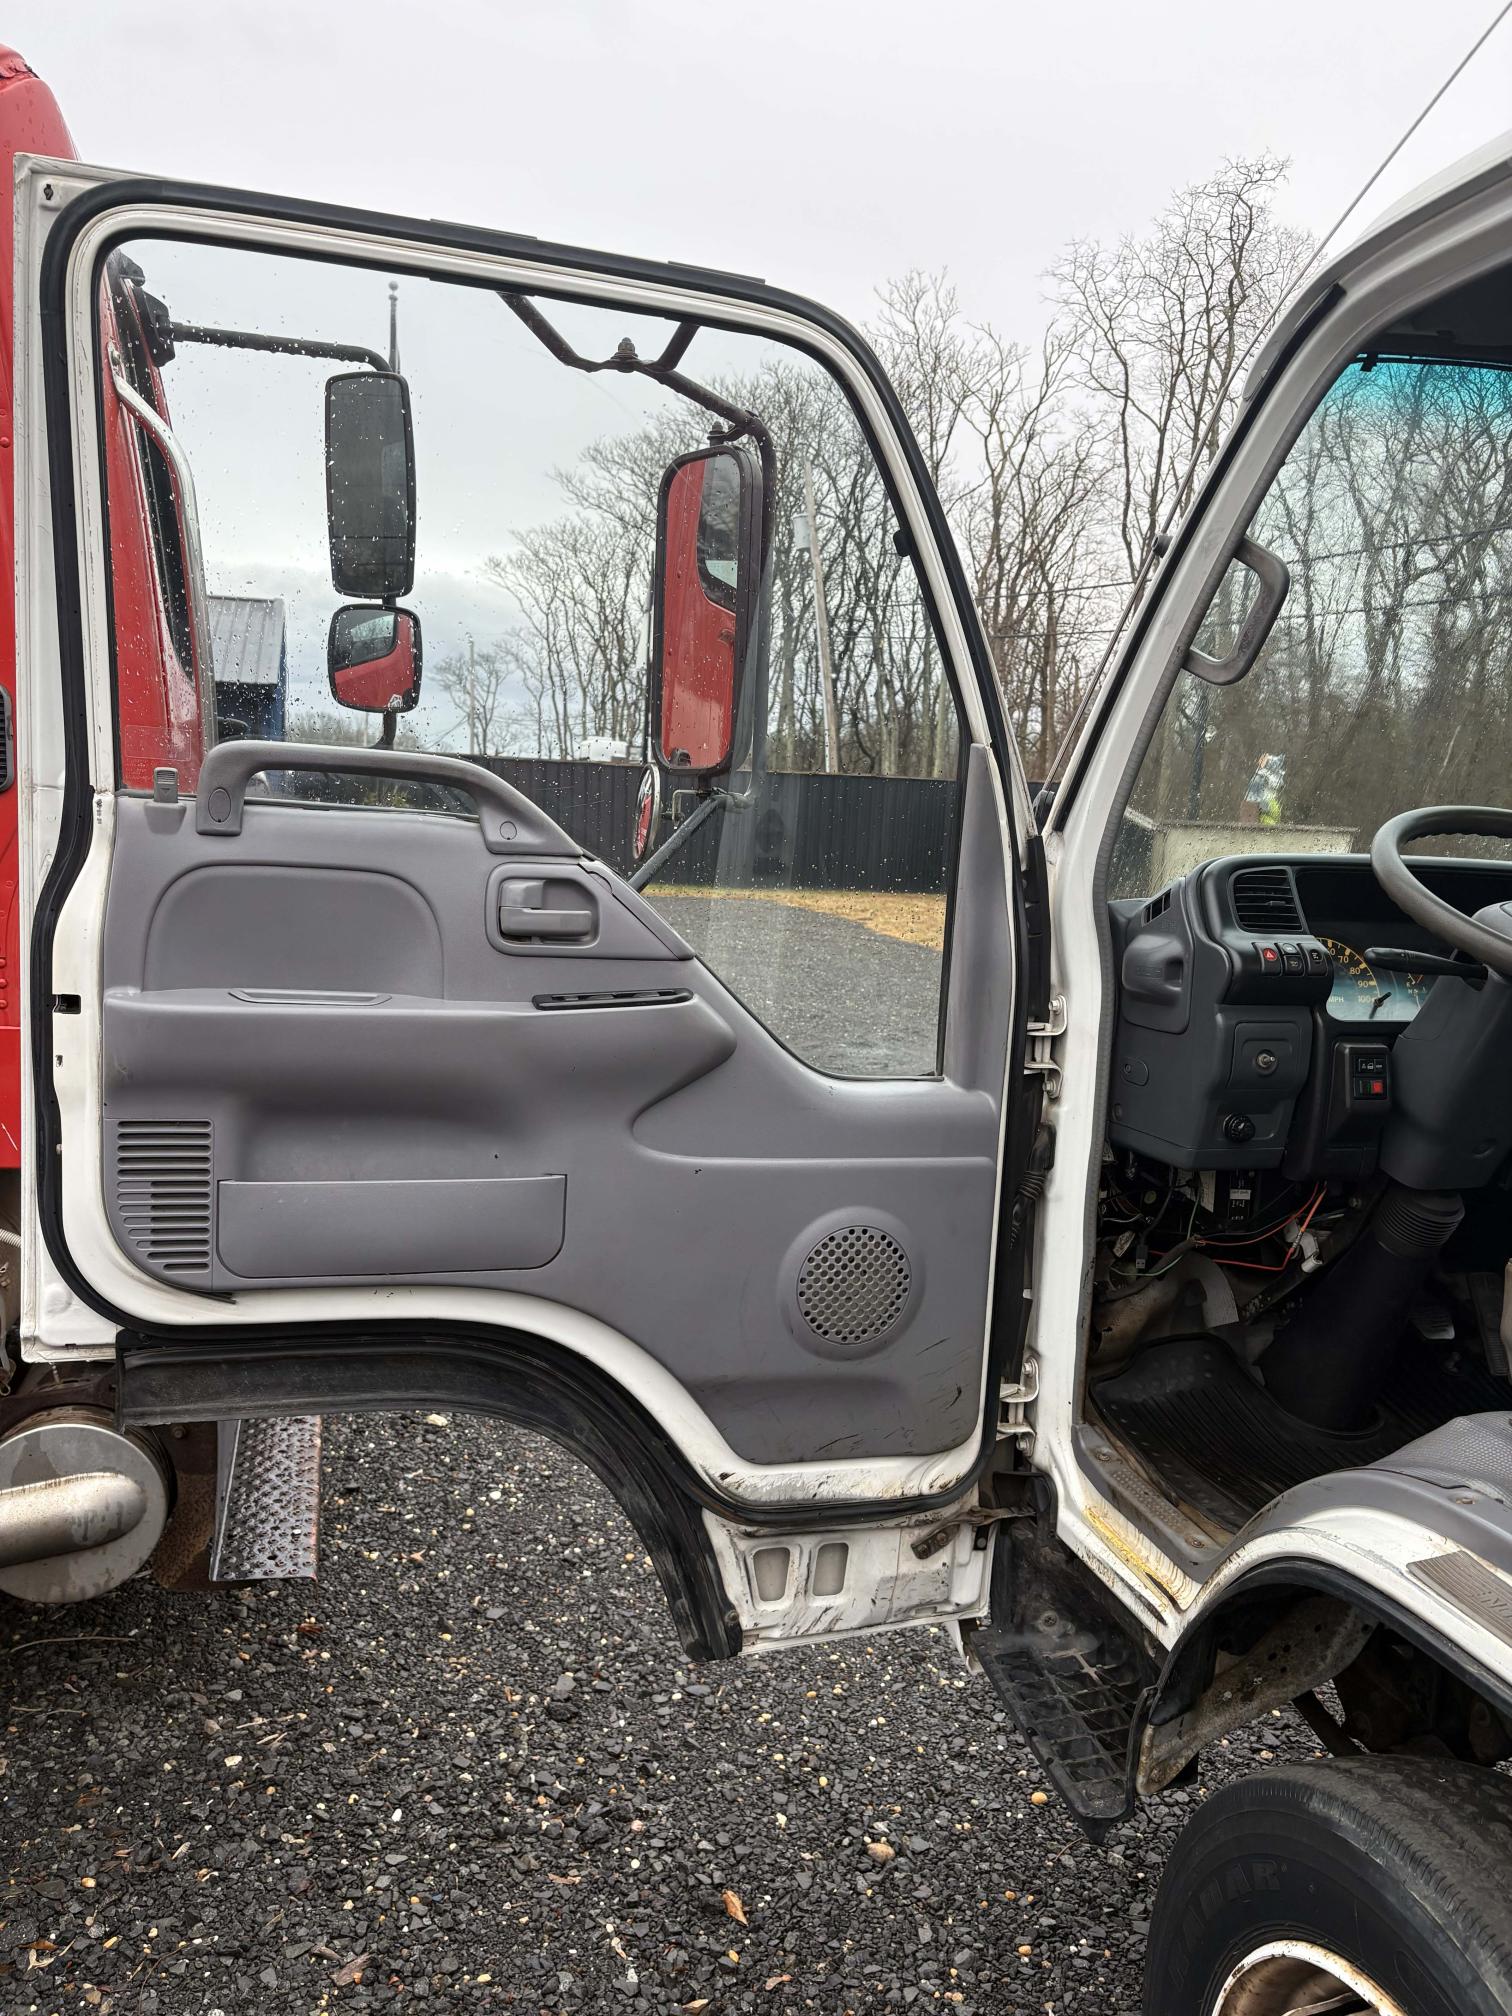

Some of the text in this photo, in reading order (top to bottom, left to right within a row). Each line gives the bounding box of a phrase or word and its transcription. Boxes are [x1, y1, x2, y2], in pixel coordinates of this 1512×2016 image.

[1338, 955, 1349, 963] 70
[1350, 967, 1361, 975] 80
[1358, 980, 1369, 988] 90
[1328, 995, 1344, 1004] MPH
[1358, 995, 1371, 1004] 100
